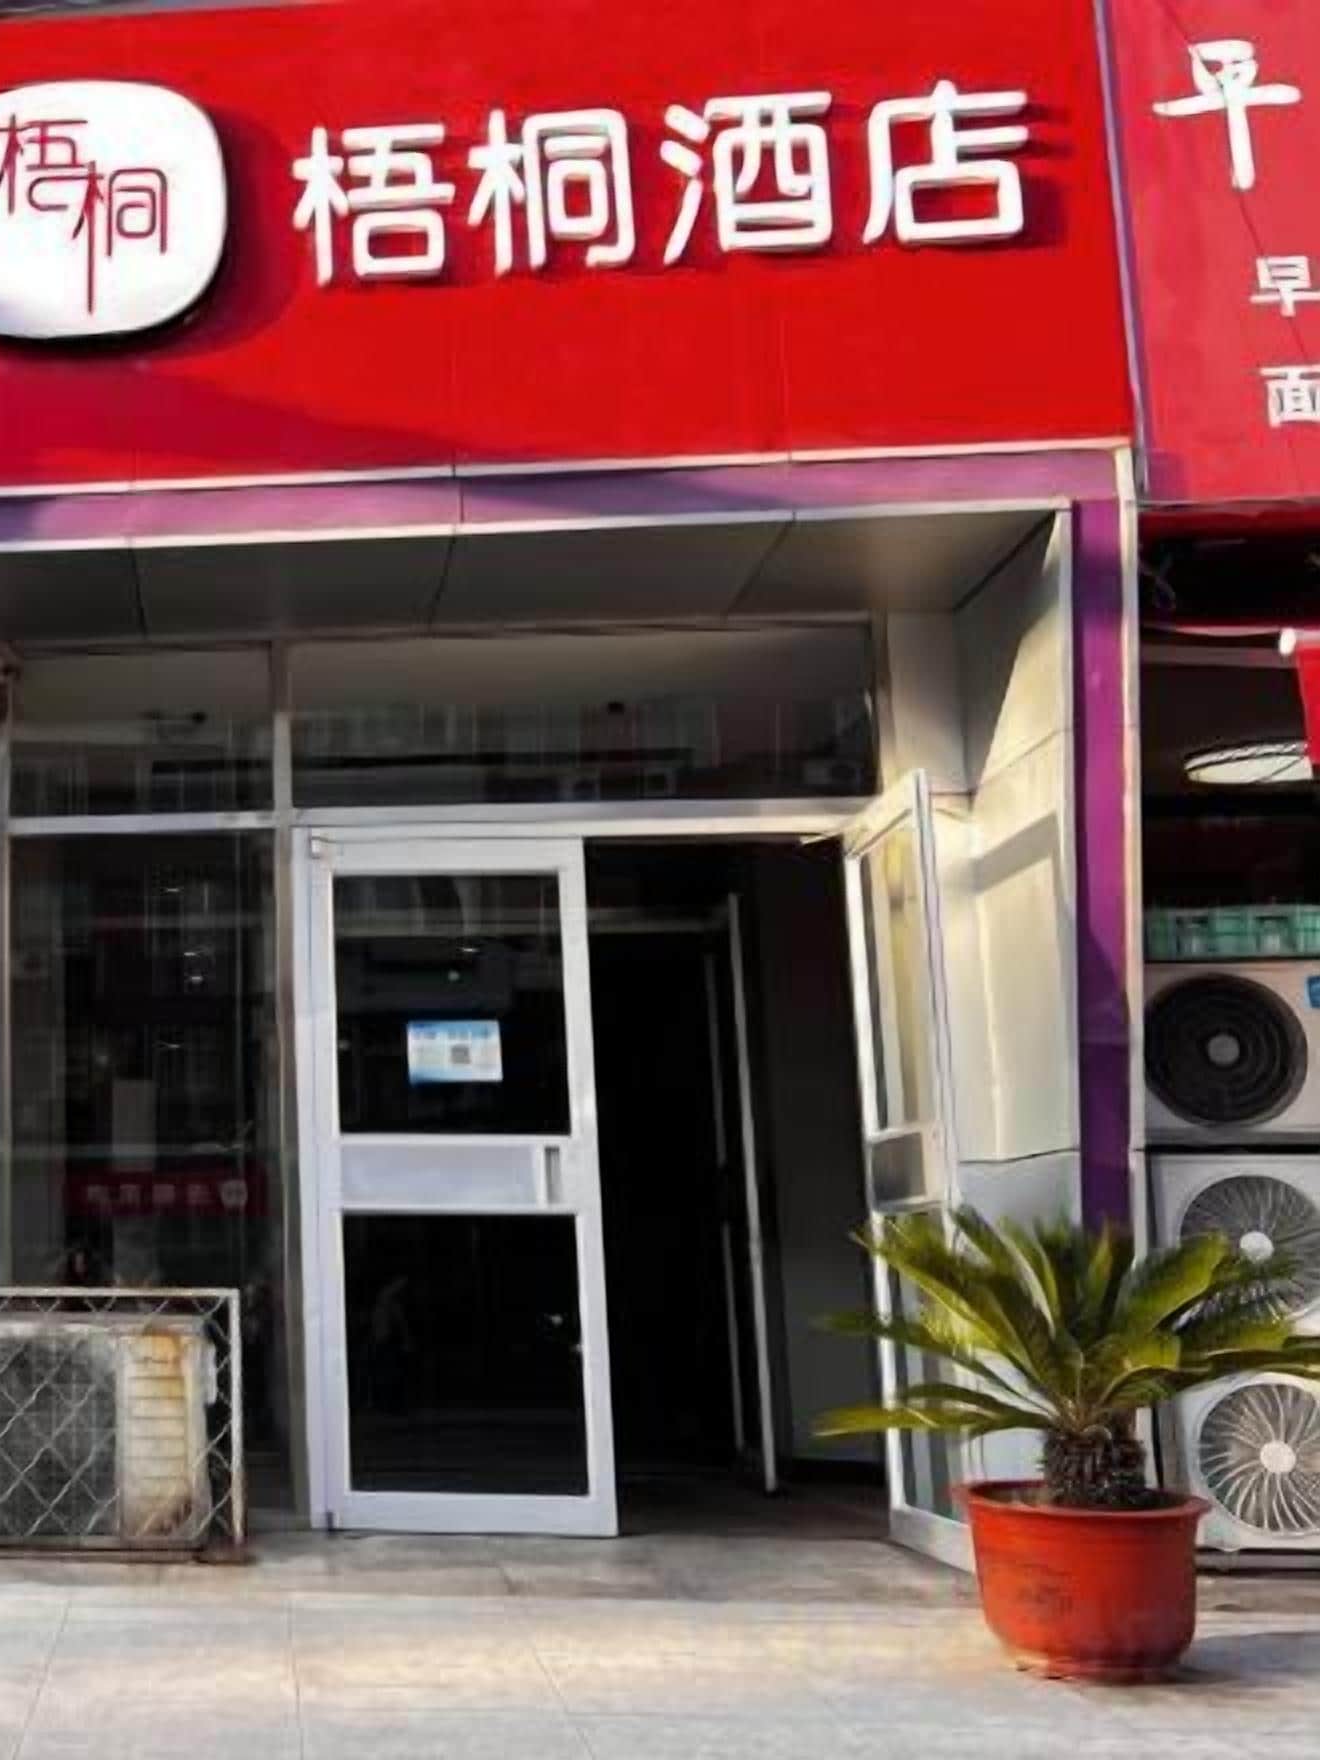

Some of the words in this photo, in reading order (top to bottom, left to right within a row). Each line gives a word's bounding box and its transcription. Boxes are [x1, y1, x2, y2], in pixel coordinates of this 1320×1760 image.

[292, 79, 1029, 286] 梧桐酒店
[1250, 255, 1320, 317] 早
[1259, 364, 1320, 428] 面
